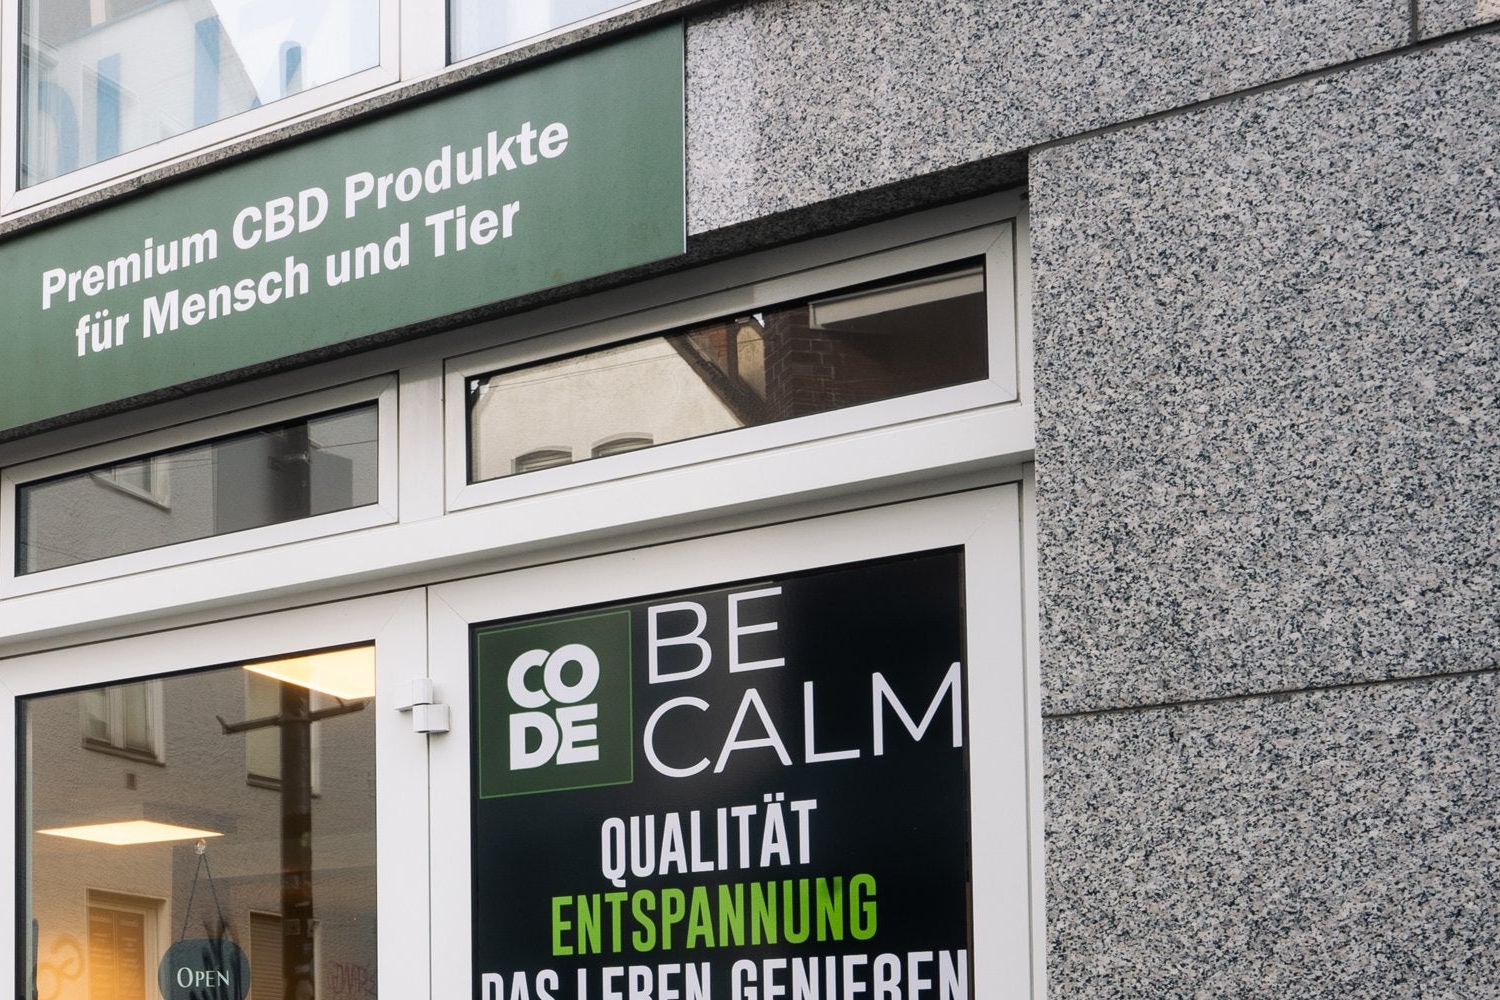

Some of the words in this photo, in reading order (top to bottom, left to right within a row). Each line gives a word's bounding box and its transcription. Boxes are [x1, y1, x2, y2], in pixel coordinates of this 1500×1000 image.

[42, 227, 218, 309] Premium
[232, 187, 328, 250] CBD
[345, 121, 569, 218] Produkte
[76, 311, 130, 357] für
[142, 258, 309, 339] Mensch
[326, 224, 410, 286] und
[424, 201, 521, 258] Tier
[648, 586, 785, 684] BE
[643, 661, 963, 778] CALM
[601, 792, 818, 888] QUALITÄT
[551, 873, 878, 956] ENTSPANNUNG
